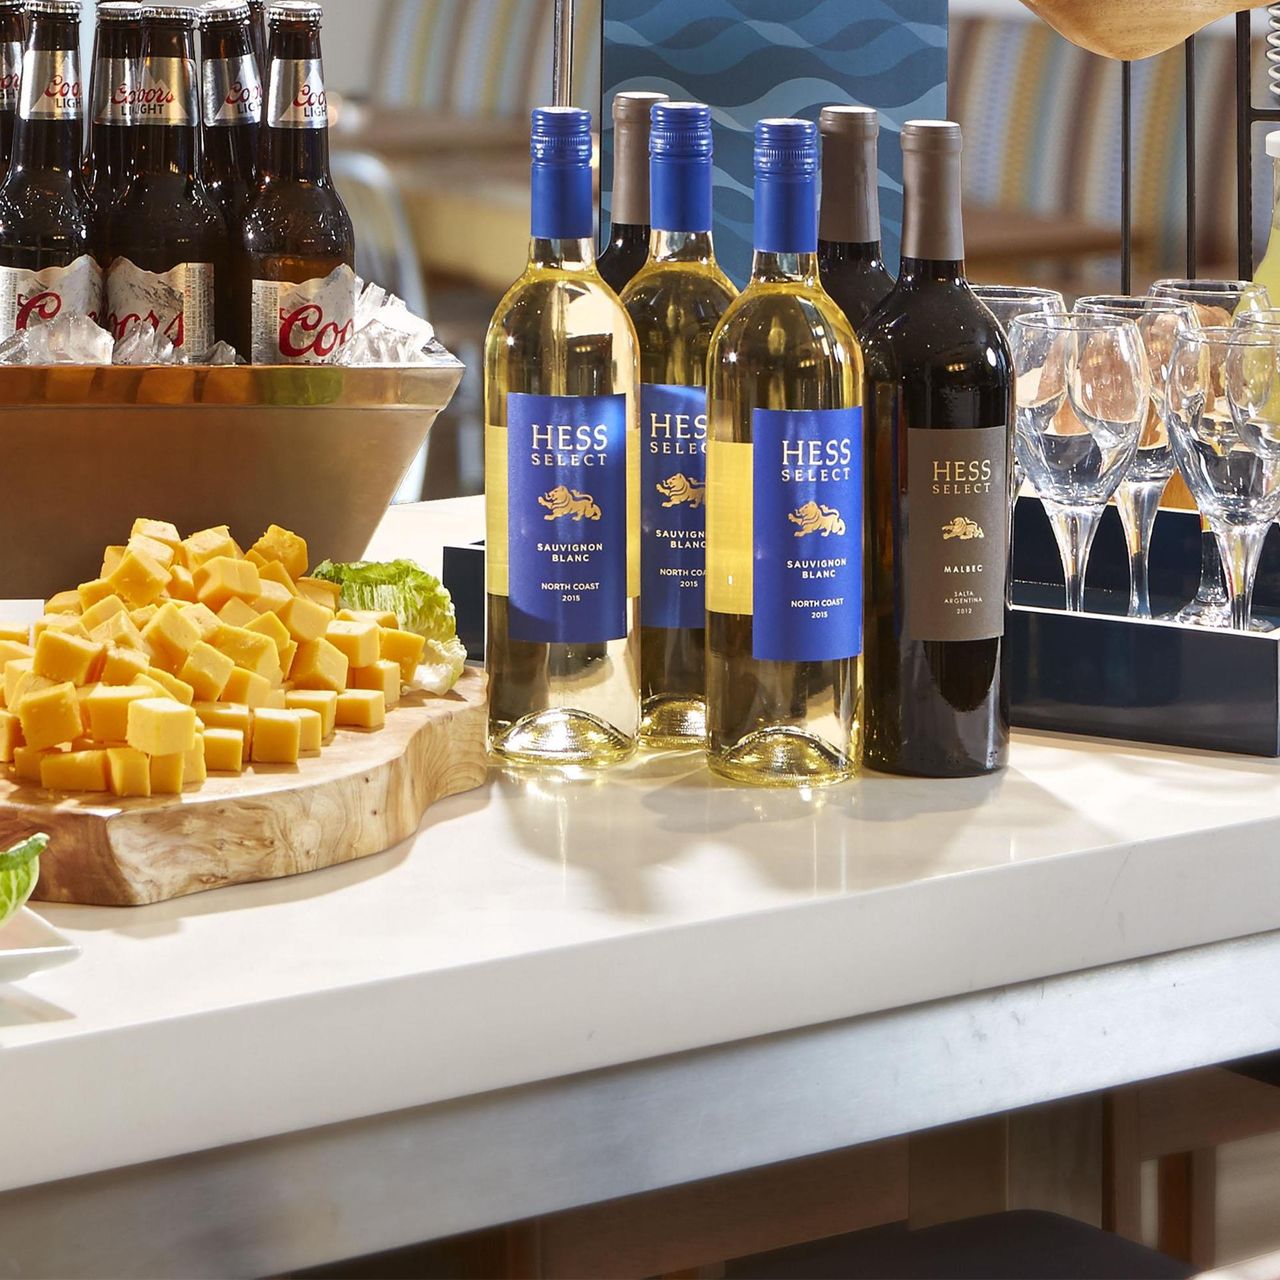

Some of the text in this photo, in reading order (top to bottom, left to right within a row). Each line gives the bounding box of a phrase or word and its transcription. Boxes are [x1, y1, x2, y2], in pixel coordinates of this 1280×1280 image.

[650, 413, 707, 439] HES
[531, 424, 609, 451] HESS
[650, 442, 707, 455] SELEC
[781, 438, 851, 466] HESS
[531, 453, 608, 466] SELECT
[781, 468, 850, 482] SELECT
[933, 460, 991, 482] HESS
[932, 482, 991, 494] SELECT
[656, 530, 706, 538] SAUVIGN
[537, 543, 603, 552] SAUVIGNON
[552, 554, 590, 562] BLANC
[787, 558, 847, 568] SAUVIGNON
[944, 565, 983, 573] MALBEC
[802, 570, 836, 579] BLANC
[541, 582, 600, 590] NORTH COAST
[791, 598, 844, 608] NORTH COAST
[811, 611, 828, 619] 2015
